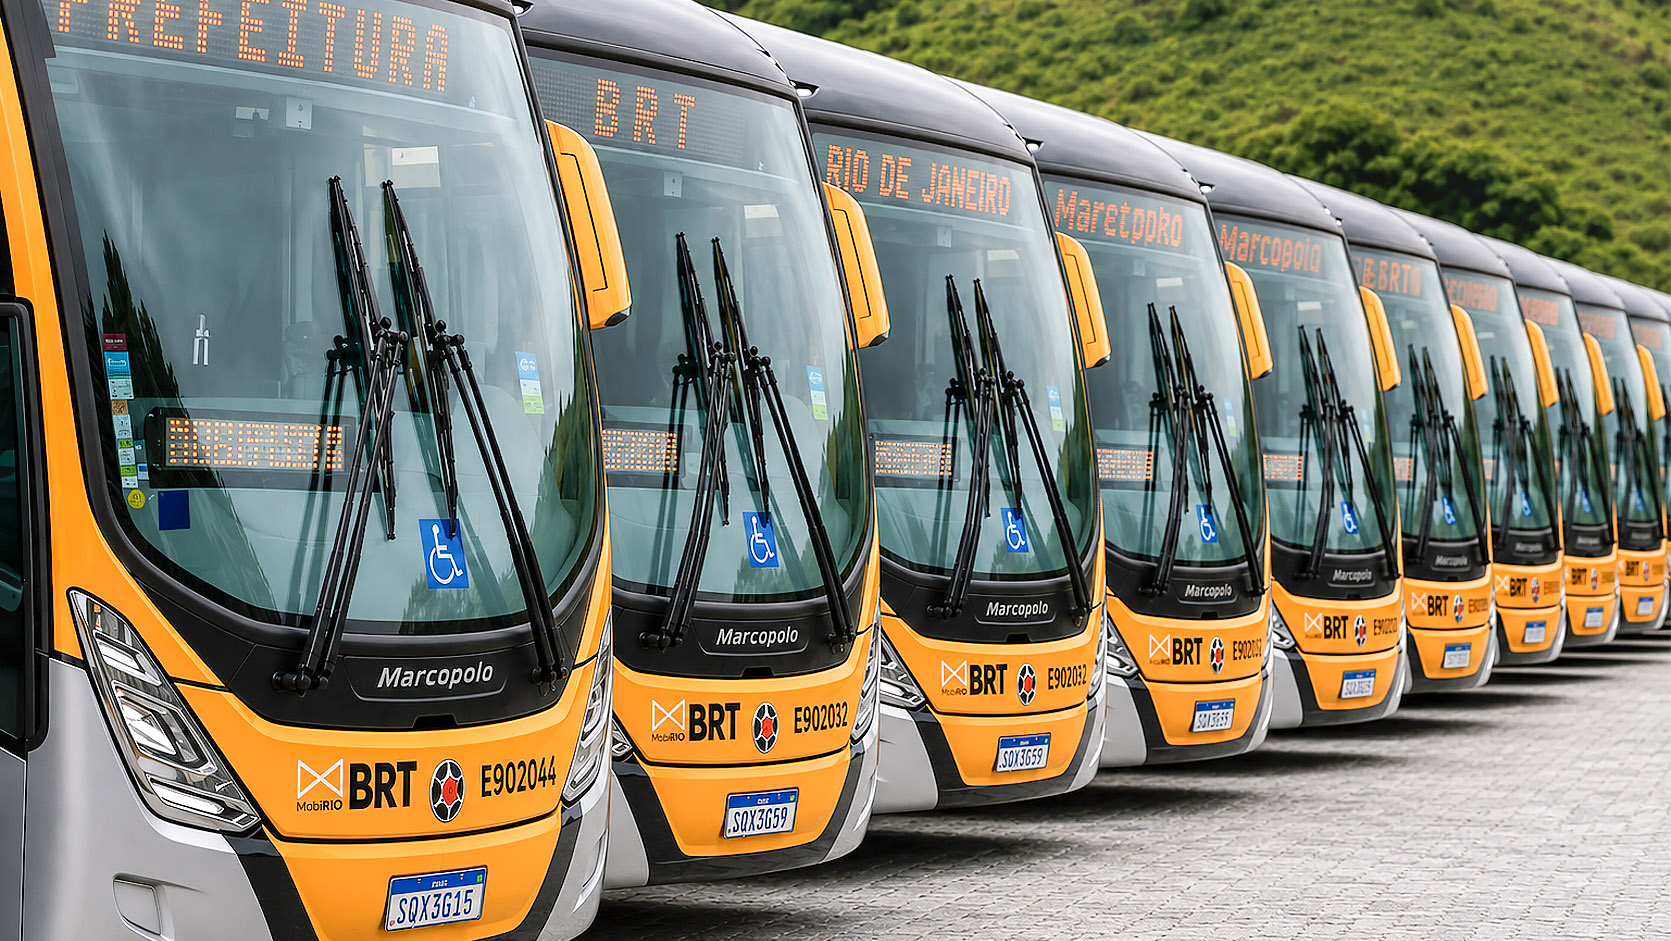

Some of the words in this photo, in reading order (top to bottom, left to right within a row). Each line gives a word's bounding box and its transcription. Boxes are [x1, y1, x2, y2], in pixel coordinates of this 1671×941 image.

[594, 78, 695, 149] BRT
[826, 144, 870, 193] RIO
[879, 154, 912, 199] DE
[921, 162, 1011, 216] JANEIRO
[1185, 583, 1233, 599] Marcopolo
[986, 600, 1049, 619] Marcopolo
[1427, 595, 1449, 616] BRT
[716, 626, 799, 648] Marcopolo
[1324, 615, 1349, 639] BRT
[1172, 637, 1203, 665] BRT
[377, 661, 494, 690] Marcopolo
[969, 663, 1008, 696] BRT
[689, 702, 741, 742] BRT
[794, 702, 848, 734] E902032
[349, 760, 418, 810] BRT
[481, 755, 557, 798] E902044
[296, 799, 343, 813] MobiRIO
[732, 806, 789, 834] SQX3G59
[396, 889, 474, 924] SQX3G15
